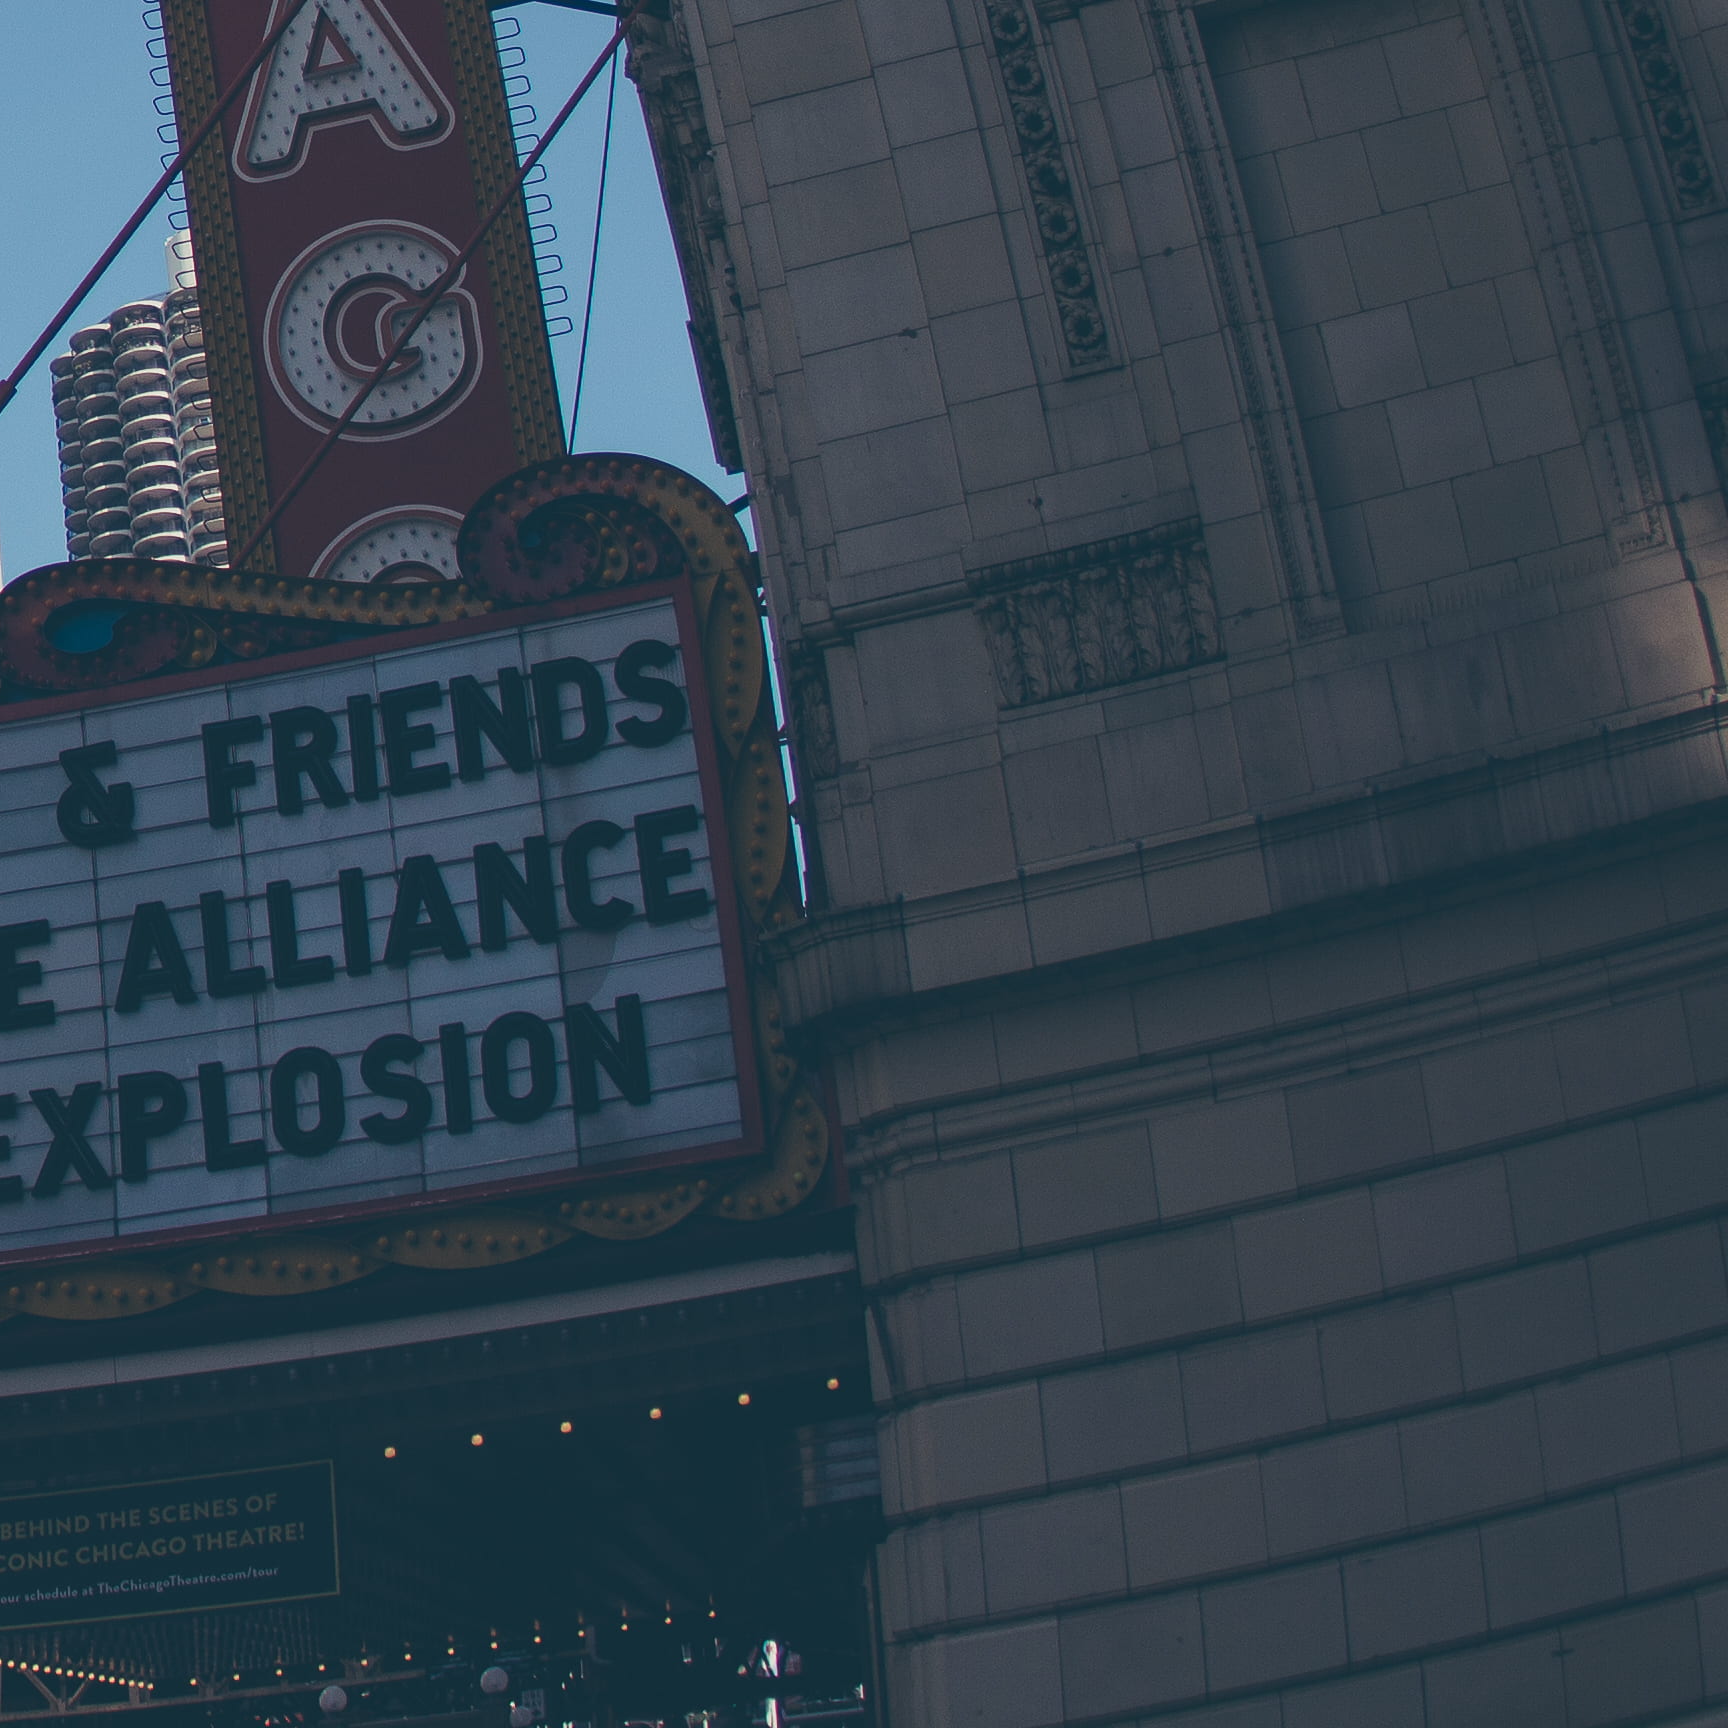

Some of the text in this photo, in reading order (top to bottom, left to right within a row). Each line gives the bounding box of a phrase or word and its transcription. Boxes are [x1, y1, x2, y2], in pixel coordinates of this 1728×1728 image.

[56, 740, 136, 847] &
[201, 639, 688, 827] FRIENDS
[113, 804, 710, 1014] ALLIANCE
[0, 1513, 91, 1543] BEHIND
[96, 1508, 142, 1532] THE
[149, 1497, 239, 1526] SCENES
[245, 1492, 279, 1514] OF
[75, 1535, 187, 1566] CHICAGO
[192, 1520, 307, 1555] THEATRE!
[24, 1584, 80, 1603] schedule
[82, 1585, 95, 1597] at
[96, 1565, 280, 1596] TheChicagoTheatre.com/tour
